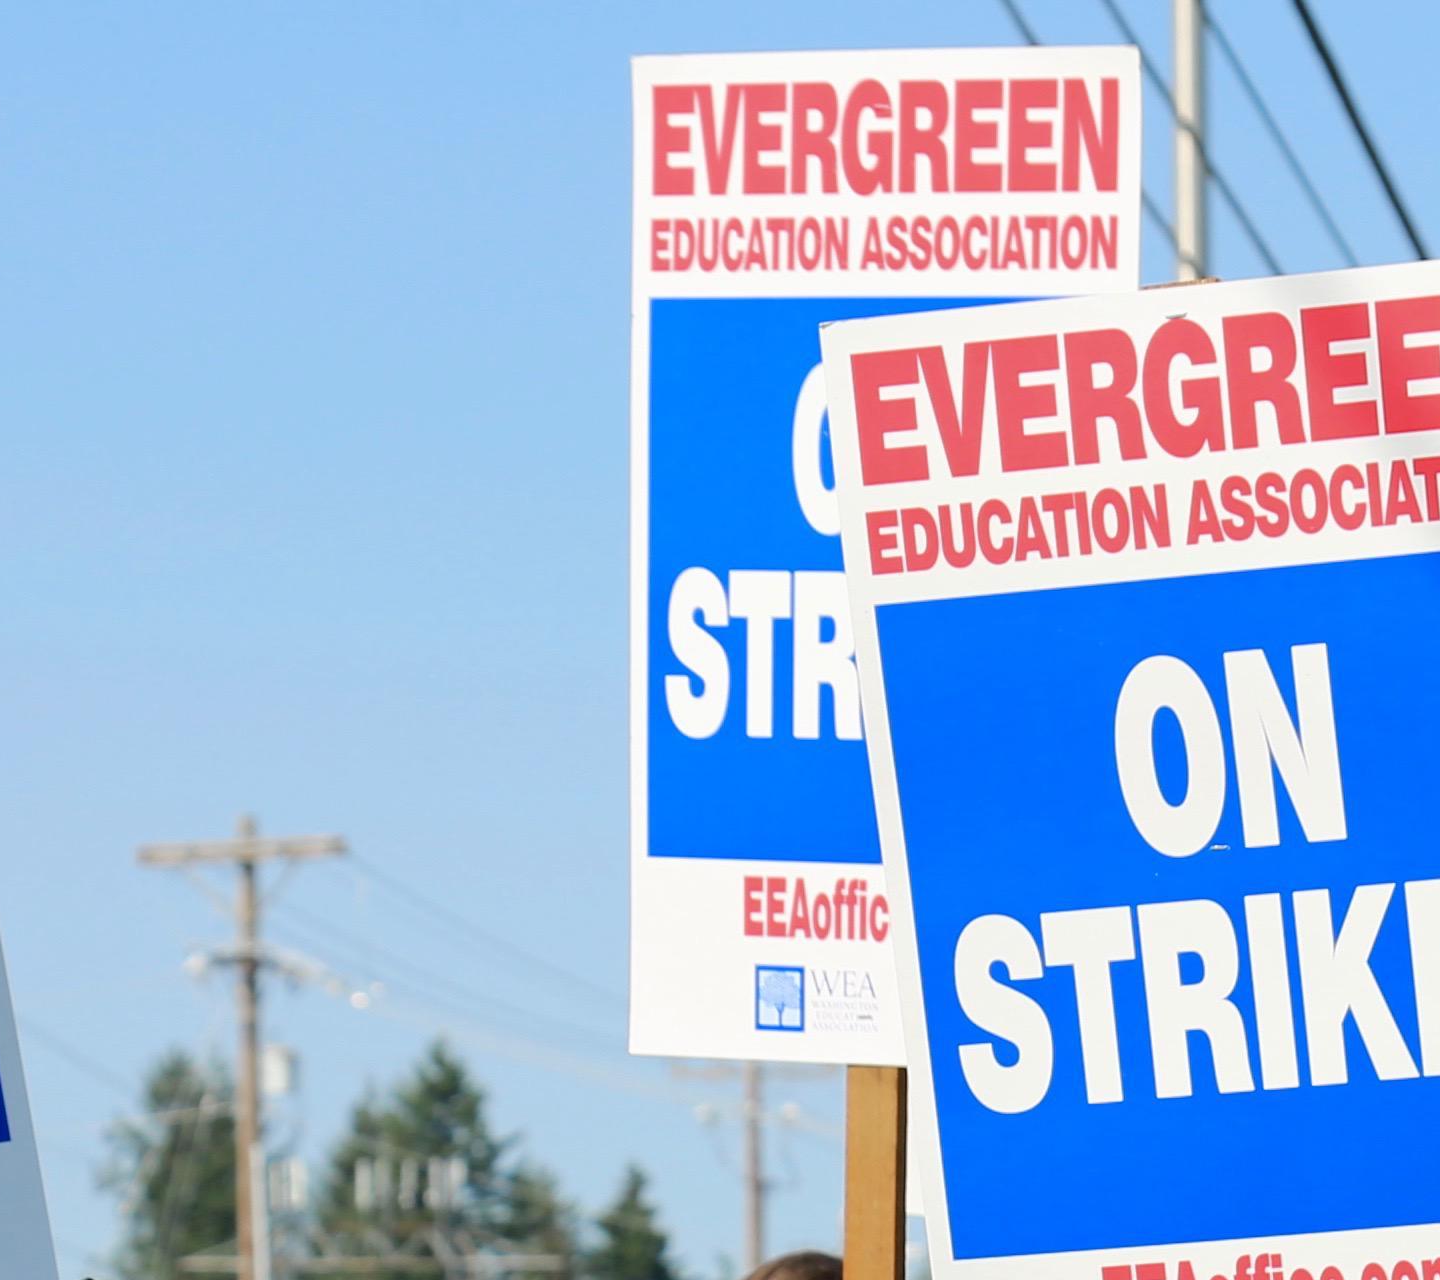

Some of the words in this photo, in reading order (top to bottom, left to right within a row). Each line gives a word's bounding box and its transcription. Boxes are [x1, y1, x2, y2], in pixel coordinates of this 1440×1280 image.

[651, 76, 1120, 197] EVERGREEN
[650, 216, 850, 273] EDUCATION
[860, 214, 1119, 272] ASSOCIATION
[864, 483, 1172, 576] EDUCATION
[1114, 642, 1348, 858] ON
[810, 969, 877, 999] WEA
